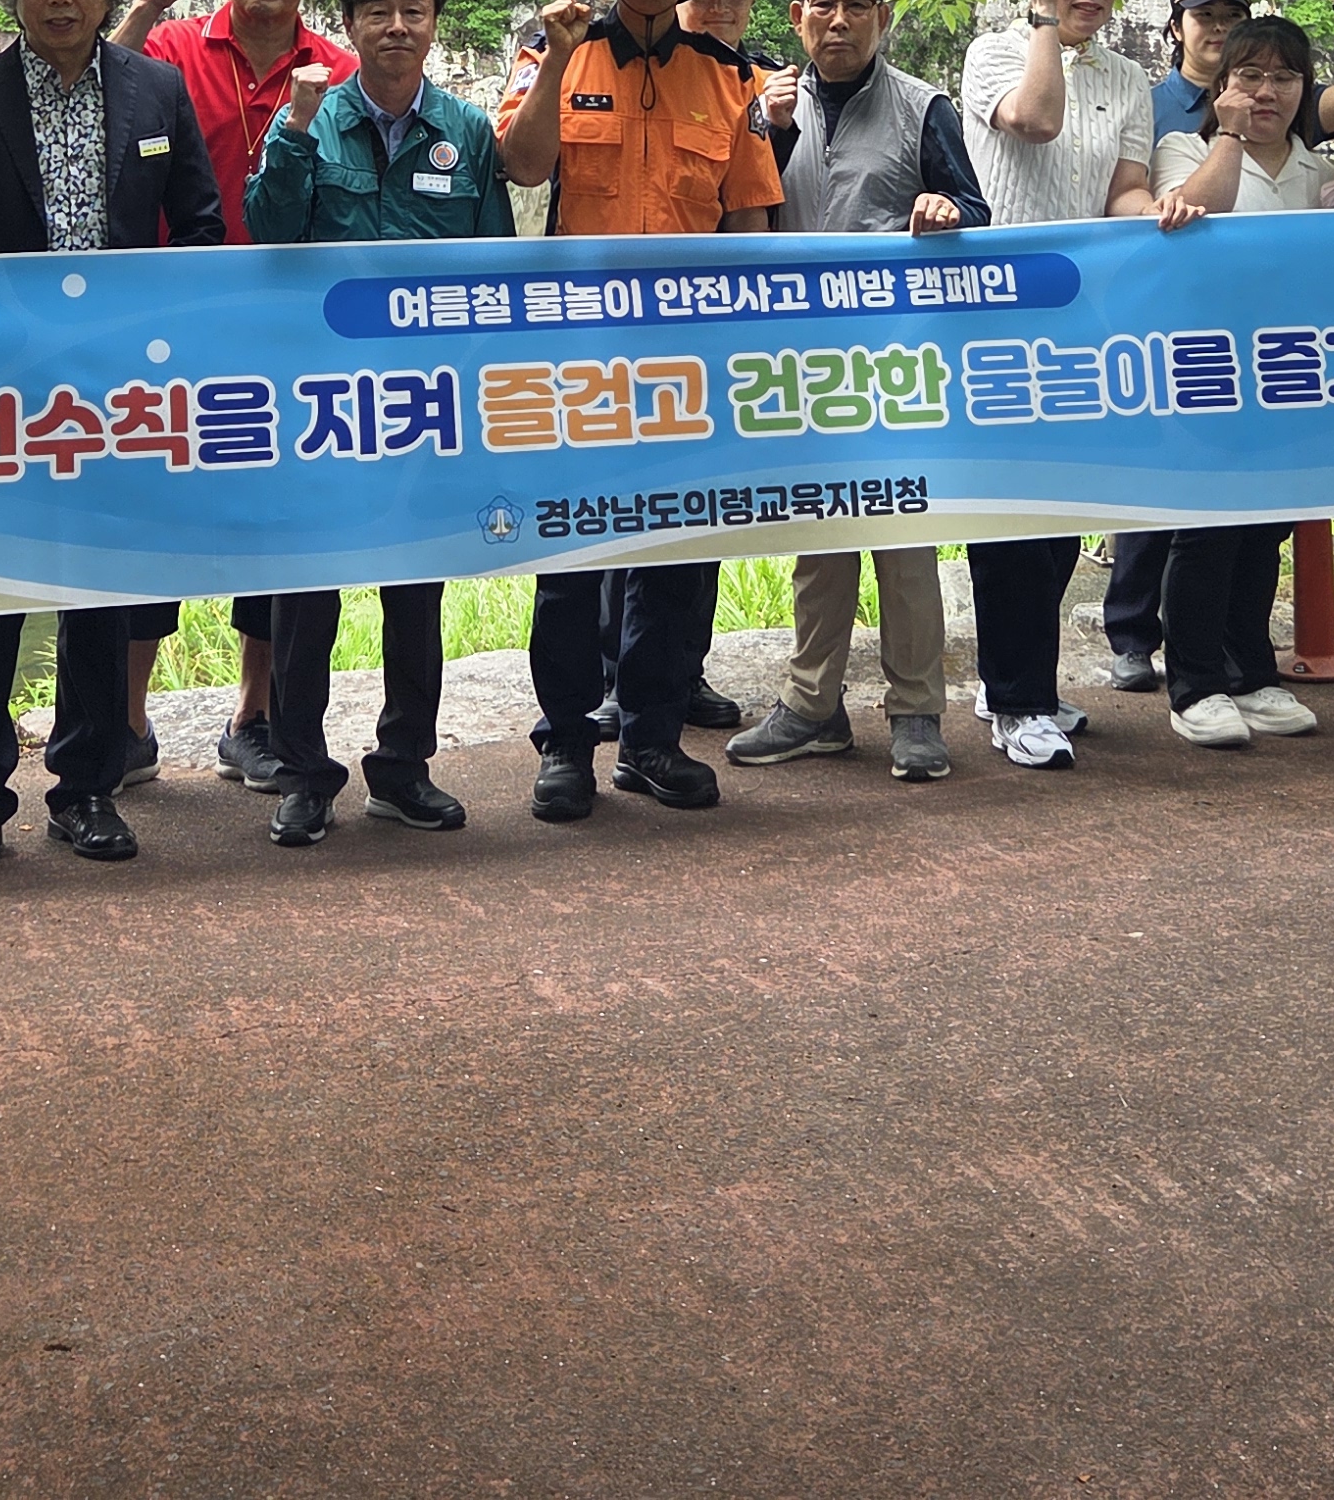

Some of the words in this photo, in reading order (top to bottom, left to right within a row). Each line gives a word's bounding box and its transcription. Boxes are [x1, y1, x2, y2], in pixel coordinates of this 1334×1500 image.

[389, 283, 512, 328] 여름철
[523, 278, 643, 323] 물놀이
[654, 273, 810, 317] 안전사고
[819, 268, 896, 309] 예방
[904, 263, 1018, 306] 캠페인
[295, 367, 461, 458] 지켜
[480, 358, 712, 450] 즐겁고
[729, 344, 949, 435] 건강한
[963, 331, 1241, 423] 물놀이를
[535, 476, 929, 538] 경상남도의령교육지원청
